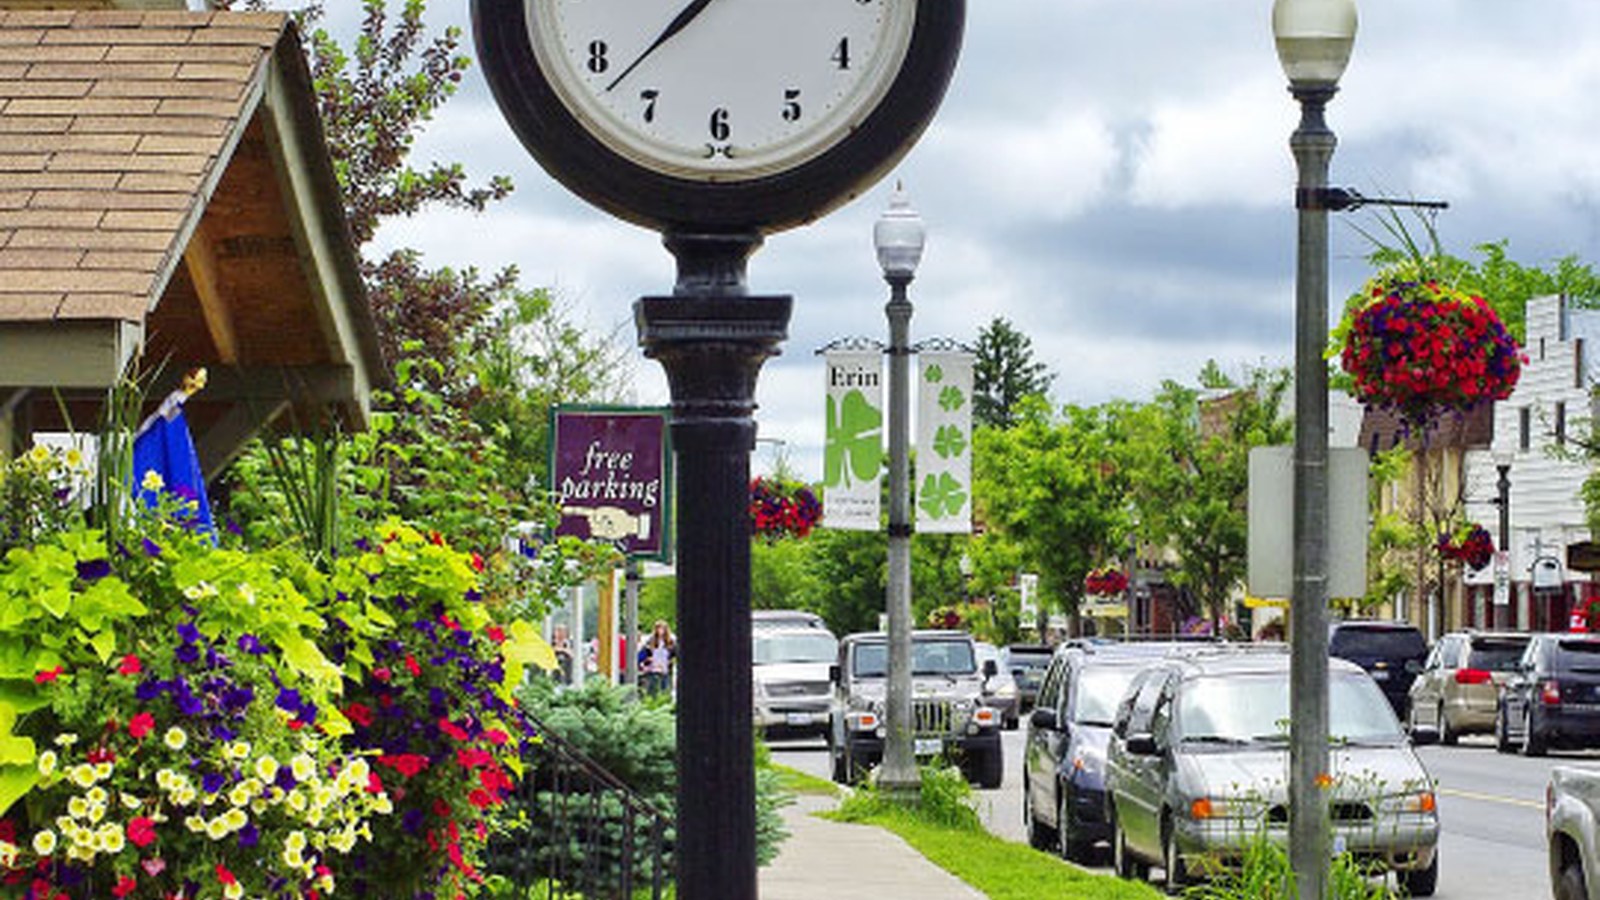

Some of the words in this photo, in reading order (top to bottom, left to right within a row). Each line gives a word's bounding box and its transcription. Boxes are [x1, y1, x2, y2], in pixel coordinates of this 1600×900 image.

[588, 40, 608, 73] 8
[831, 37, 850, 70] 4
[640, 89, 659, 123] 7
[782, 89, 801, 122] 5
[709, 108, 731, 141] 6
[831, 366, 879, 387] Erin
[580, 441, 633, 476] free
[560, 471, 659, 507] parking
